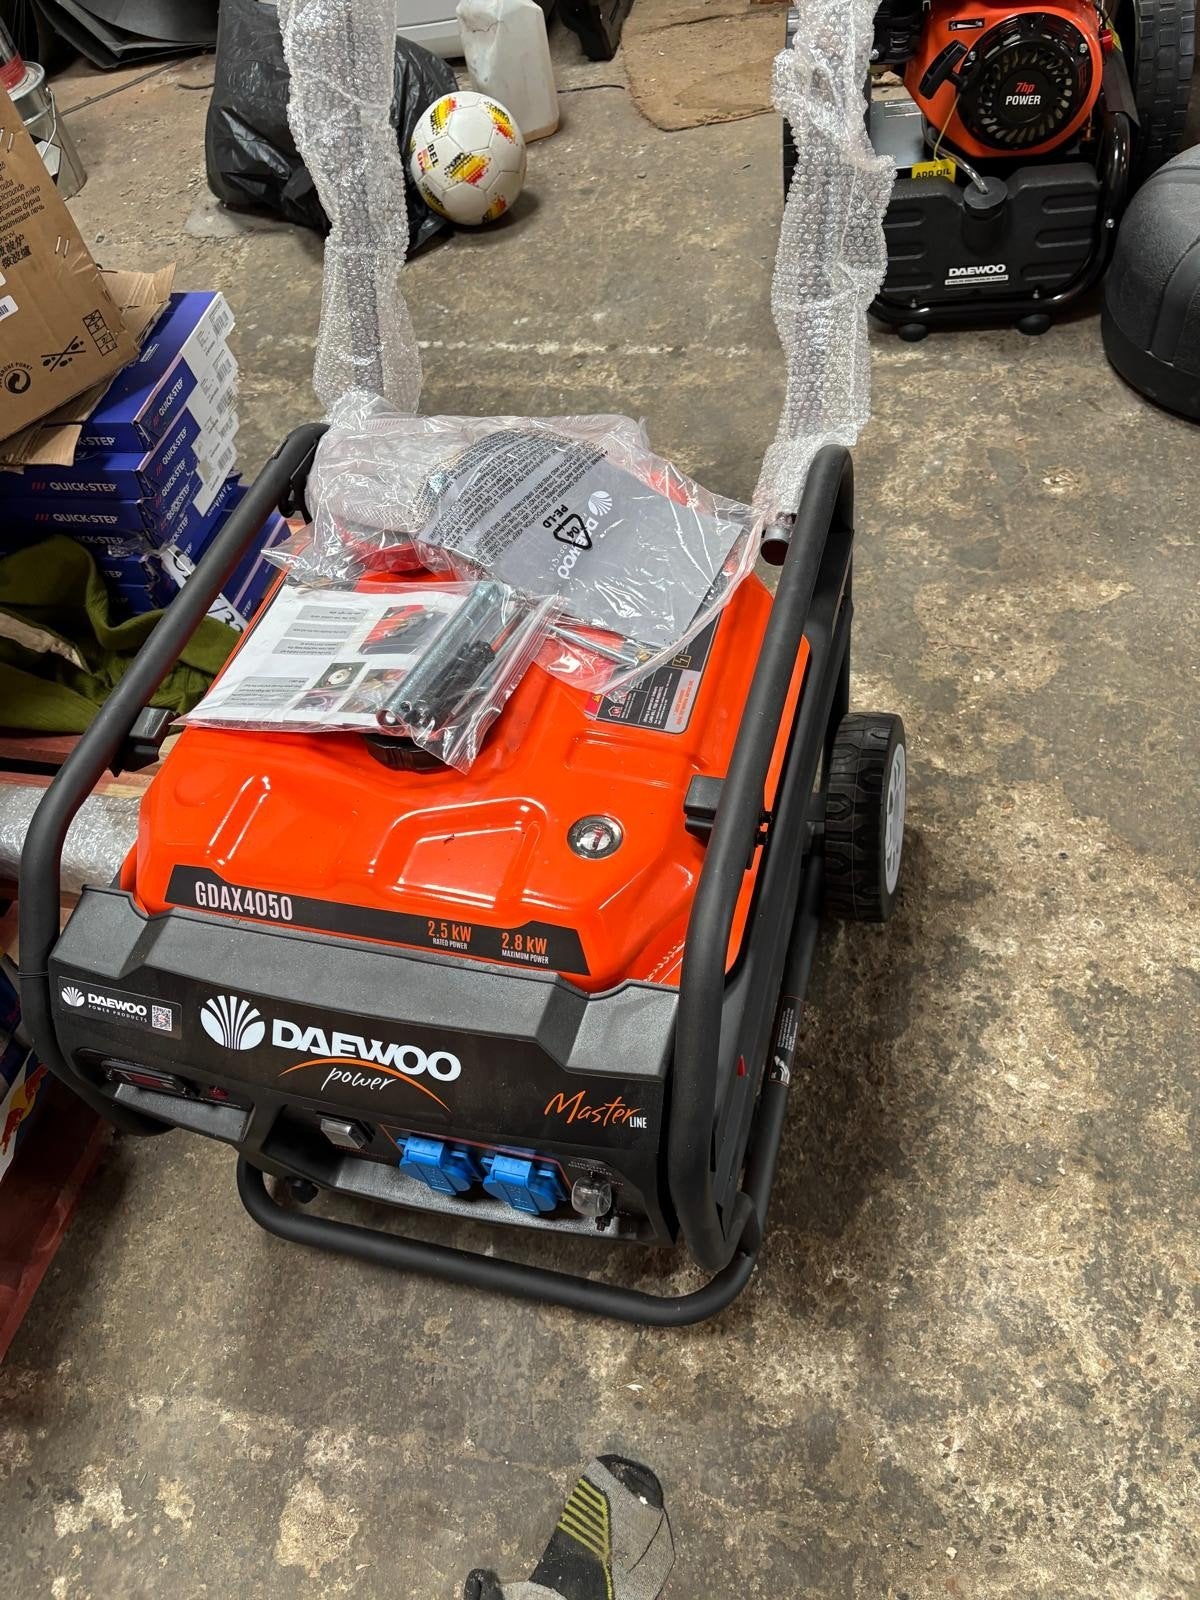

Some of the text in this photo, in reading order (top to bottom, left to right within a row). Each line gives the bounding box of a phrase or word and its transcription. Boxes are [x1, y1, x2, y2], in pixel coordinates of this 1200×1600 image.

[1015, 82, 1036, 94] 7hp
[1005, 95, 1041, 105] POWER
[427, 144, 440, 168] BEL
[916, 168, 951, 178] ADD OIL
[949, 264, 1006, 276] DAEWOO
[541, 503, 569, 529] PE-LD
[565, 525, 580, 539] 04
[195, 881, 294, 921] GDAX4050
[428, 920, 471, 942] 2.5 kW
[432, 937, 468, 950] RATED POWER
[502, 932, 547, 954] 2.8 kW
[502, 949, 549, 964] MAXIMUM POWER
[87, 993, 147, 1016] DAEWOO
[88, 1004, 110, 1013] POWER
[272, 1018, 462, 1082] DAEWOO
[321, 1066, 398, 1091] power
[544, 1090, 647, 1129] Master LINE
